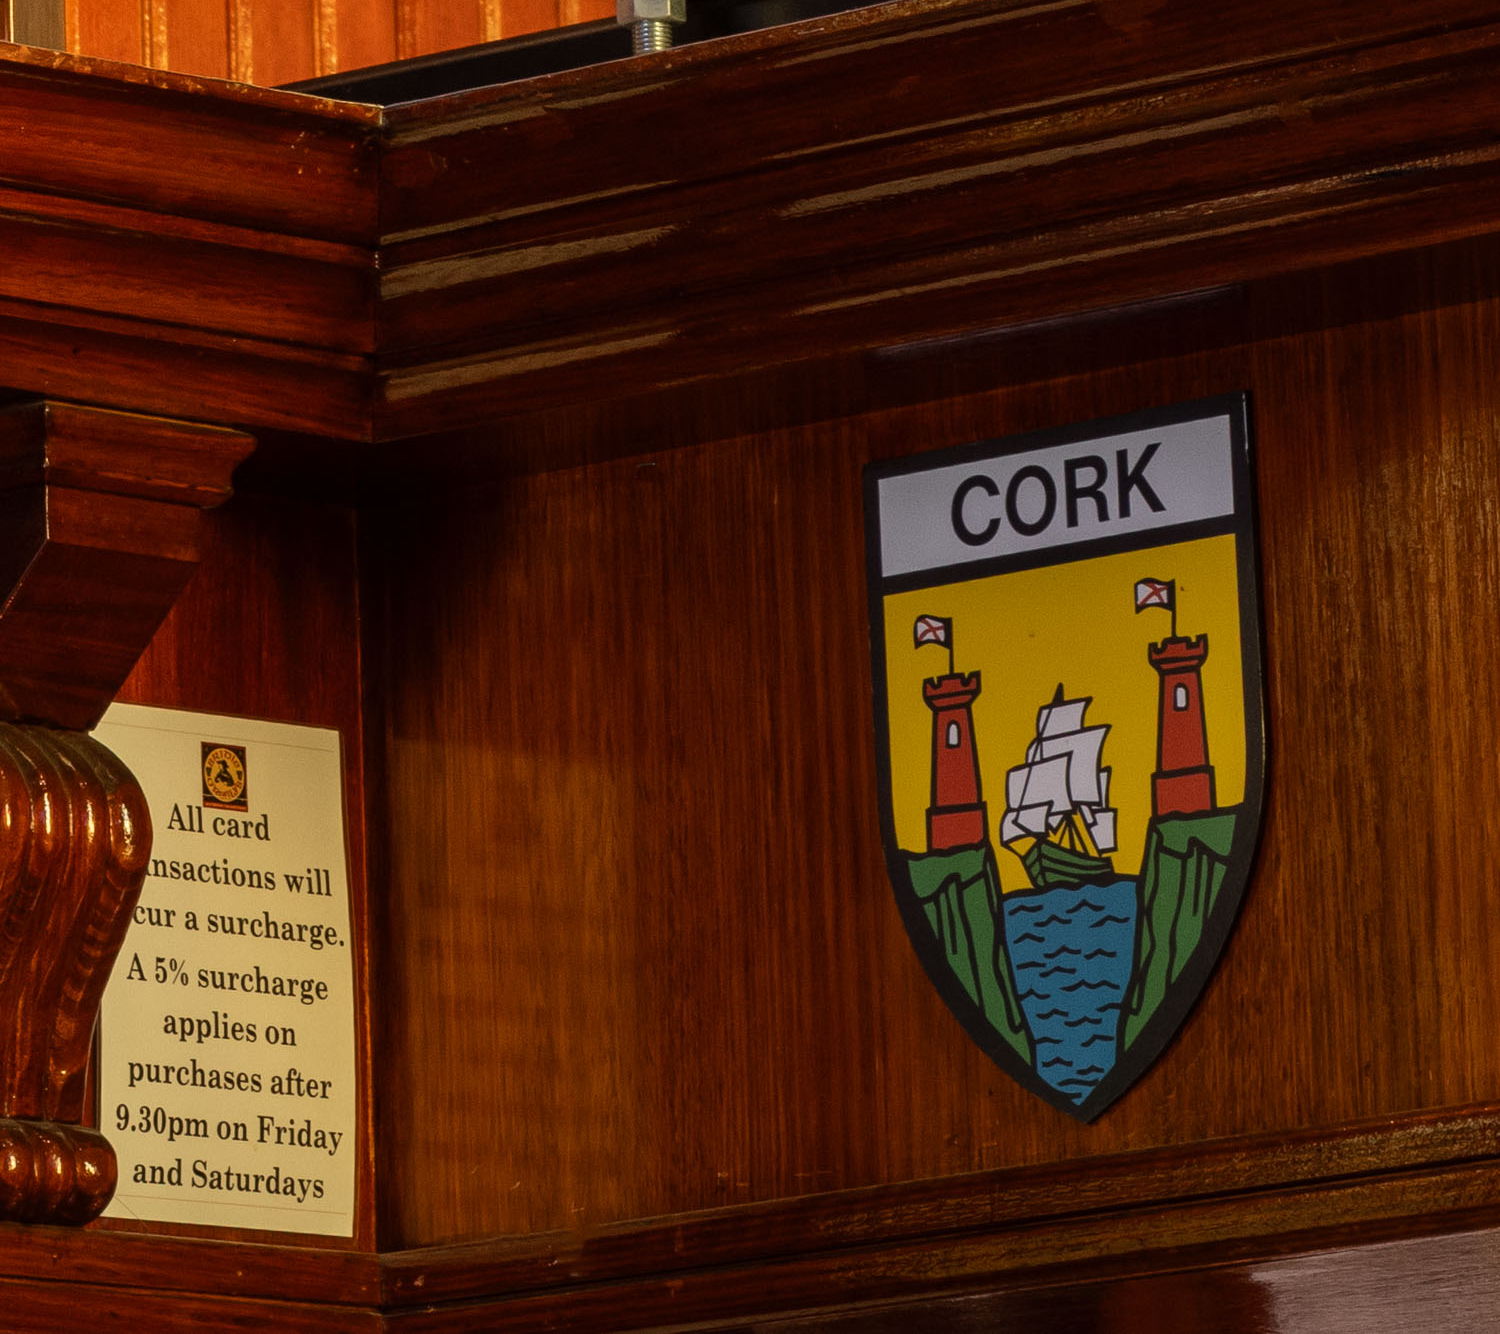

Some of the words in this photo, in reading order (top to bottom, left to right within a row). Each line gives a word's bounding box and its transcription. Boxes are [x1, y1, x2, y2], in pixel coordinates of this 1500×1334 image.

[952, 443, 1167, 549] CORK
[167, 802, 204, 834] All
[212, 811, 272, 842] card
[284, 868, 333, 898] will
[184, 910, 200, 932] a
[207, 908, 346, 951] surcharge.
[126, 952, 147, 983] A
[154, 956, 190, 988] 5%
[196, 963, 330, 1007] surcharge
[163, 1009, 258, 1045] applies
[265, 1023, 297, 1047] on
[127, 1056, 263, 1094] purchases
[270, 1070, 333, 1101] after
[115, 1102, 209, 1141] 9.30pm
[216, 1119, 249, 1143] on
[256, 1114, 344, 1156] Friday
[132, 1157, 184, 1187] and
[190, 1158, 326, 1203] Saturdays
